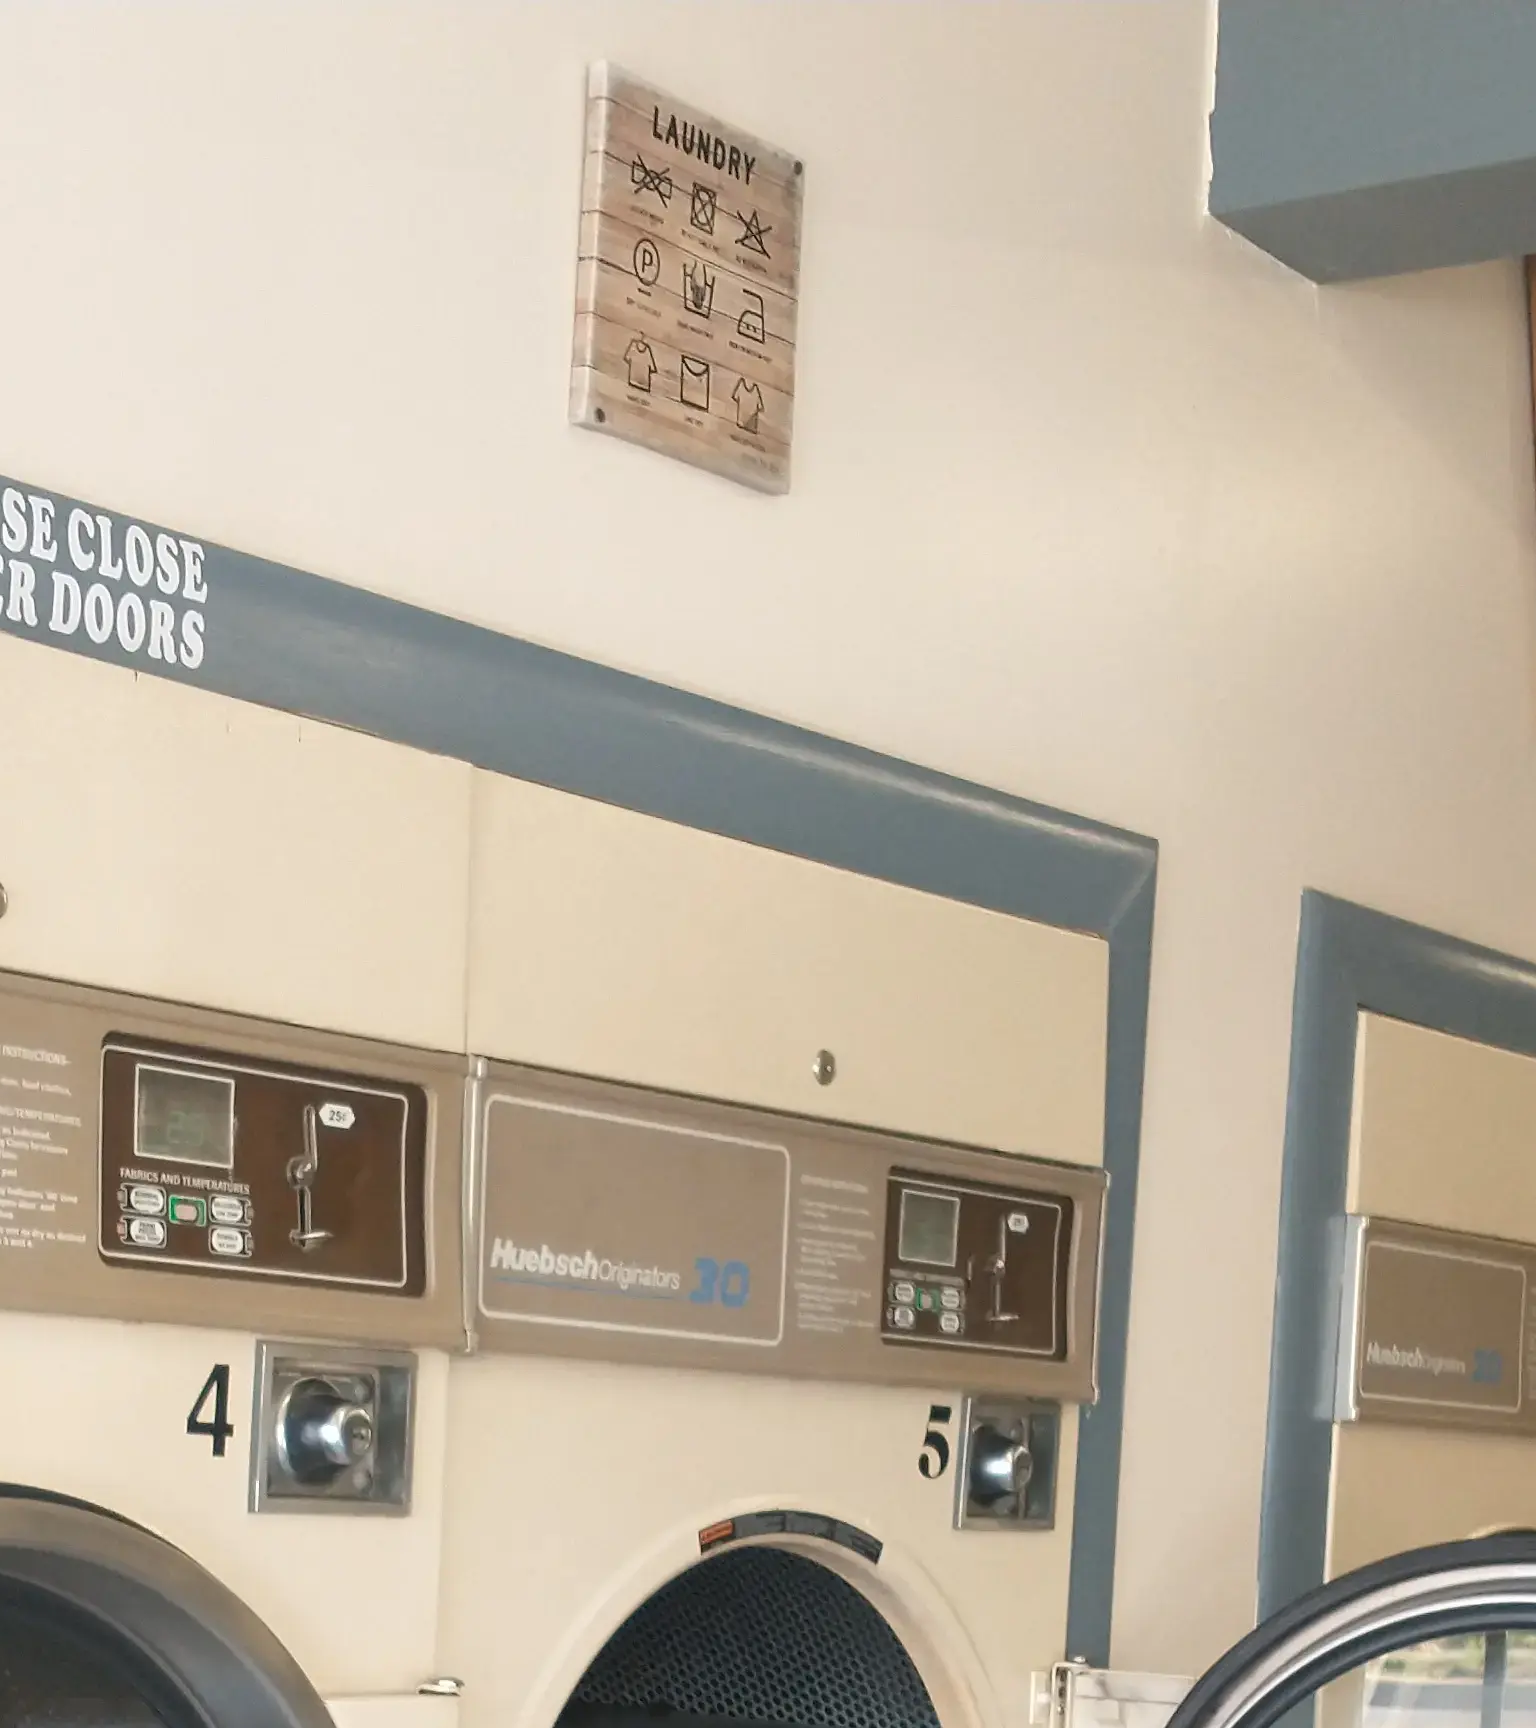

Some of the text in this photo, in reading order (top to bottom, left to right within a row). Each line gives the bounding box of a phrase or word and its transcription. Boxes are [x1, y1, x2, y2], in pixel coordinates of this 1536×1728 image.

[652, 105, 756, 186] LAUNDRY
[67, 507, 208, 603] CLOSE
[49, 570, 206, 670] DOORS
[119, 1167, 251, 1195] FABRICS AND TEMPERATURES
[490, 1237, 750, 1309] Huebsch Originators 30
[186, 1364, 234, 1457] 4
[917, 1405, 952, 1480] 5
